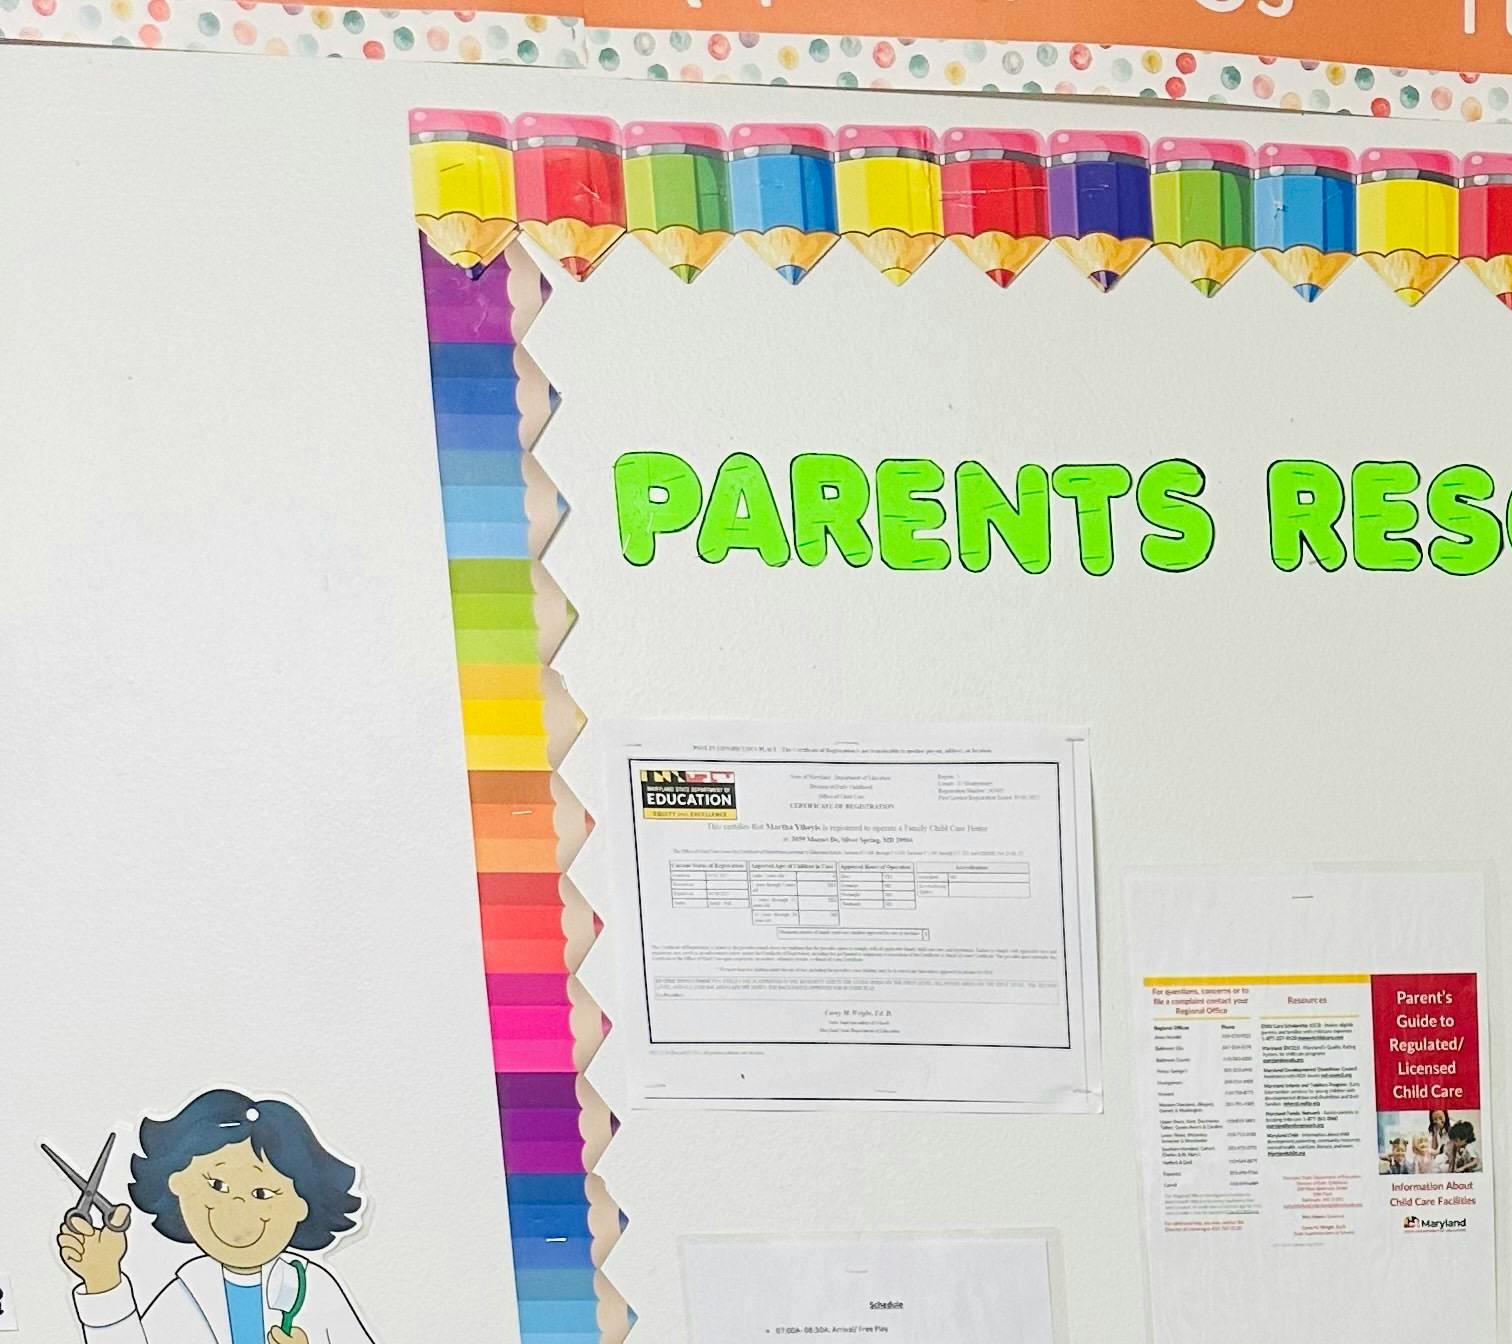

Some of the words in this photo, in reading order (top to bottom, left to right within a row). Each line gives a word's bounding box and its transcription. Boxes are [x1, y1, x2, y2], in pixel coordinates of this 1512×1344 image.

[613, 452, 1215, 576] PARENTS
[647, 793, 732, 806] EDUCATION
[1234, 998, 1248, 1006] your
[1288, 996, 1327, 1004] Resources
[1397, 990, 1453, 1004] Parent's
[1176, 1007, 1205, 1015] Regional
[1396, 1014, 1437, 1028] Guide
[1440, 1015, 1454, 1027] to
[1389, 1036, 1464, 1054] Regulated/
[1398, 1060, 1456, 1075] Licensed
[1393, 1085, 1428, 1098] Child
[1431, 1084, 1463, 1098] Care
[1392, 1182, 1443, 1191] Information
[1446, 1182, 1473, 1190] About
[1390, 1198, 1412, 1206] Child
[1415, 1198, 1435, 1206] Care
[1438, 1196, 1476, 1205] Facilities
[1421, 1218, 1466, 1229] Maryland
